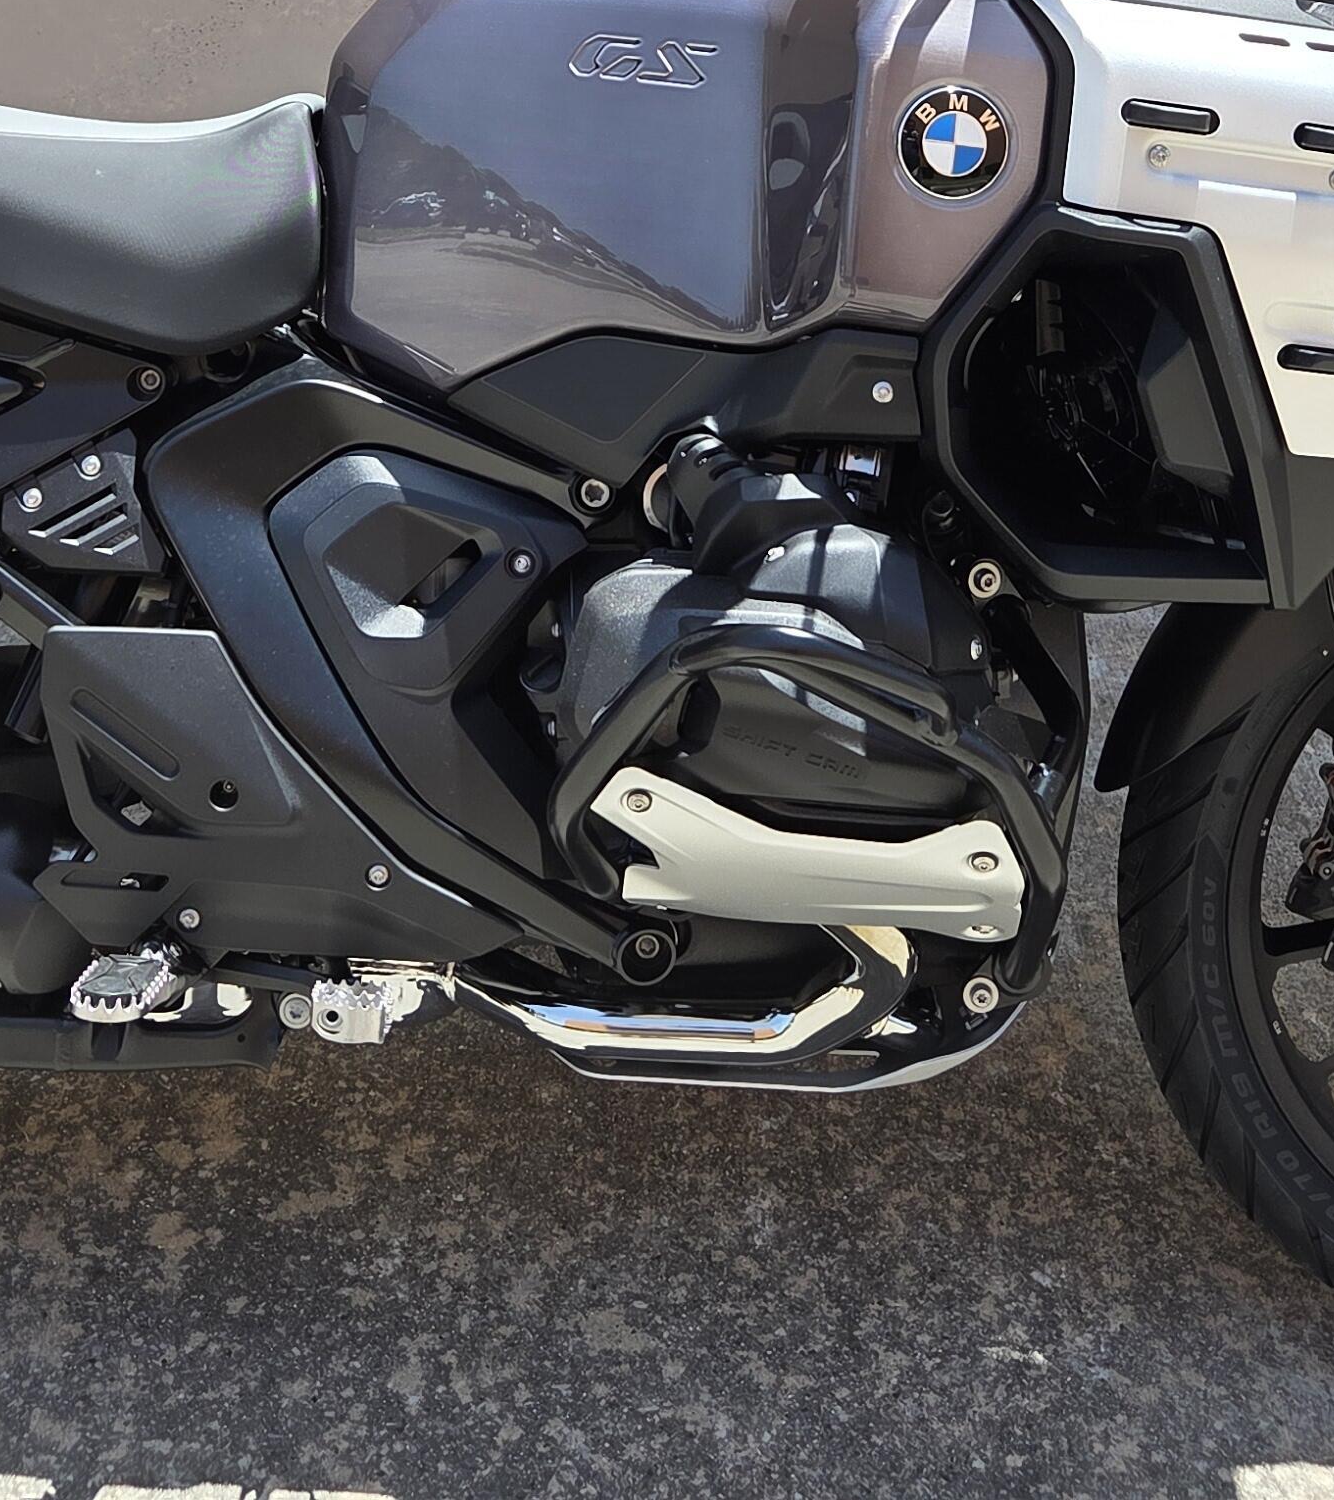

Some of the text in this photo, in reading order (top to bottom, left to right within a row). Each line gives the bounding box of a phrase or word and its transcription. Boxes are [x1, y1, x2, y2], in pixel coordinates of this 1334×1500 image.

[568, 33, 718, 89] GS
[914, 93, 1001, 132] BMW
[1201, 875, 1219, 947] 60V
[1202, 963, 1239, 1058] M/C
[1230, 1071, 1279, 1140] R19
